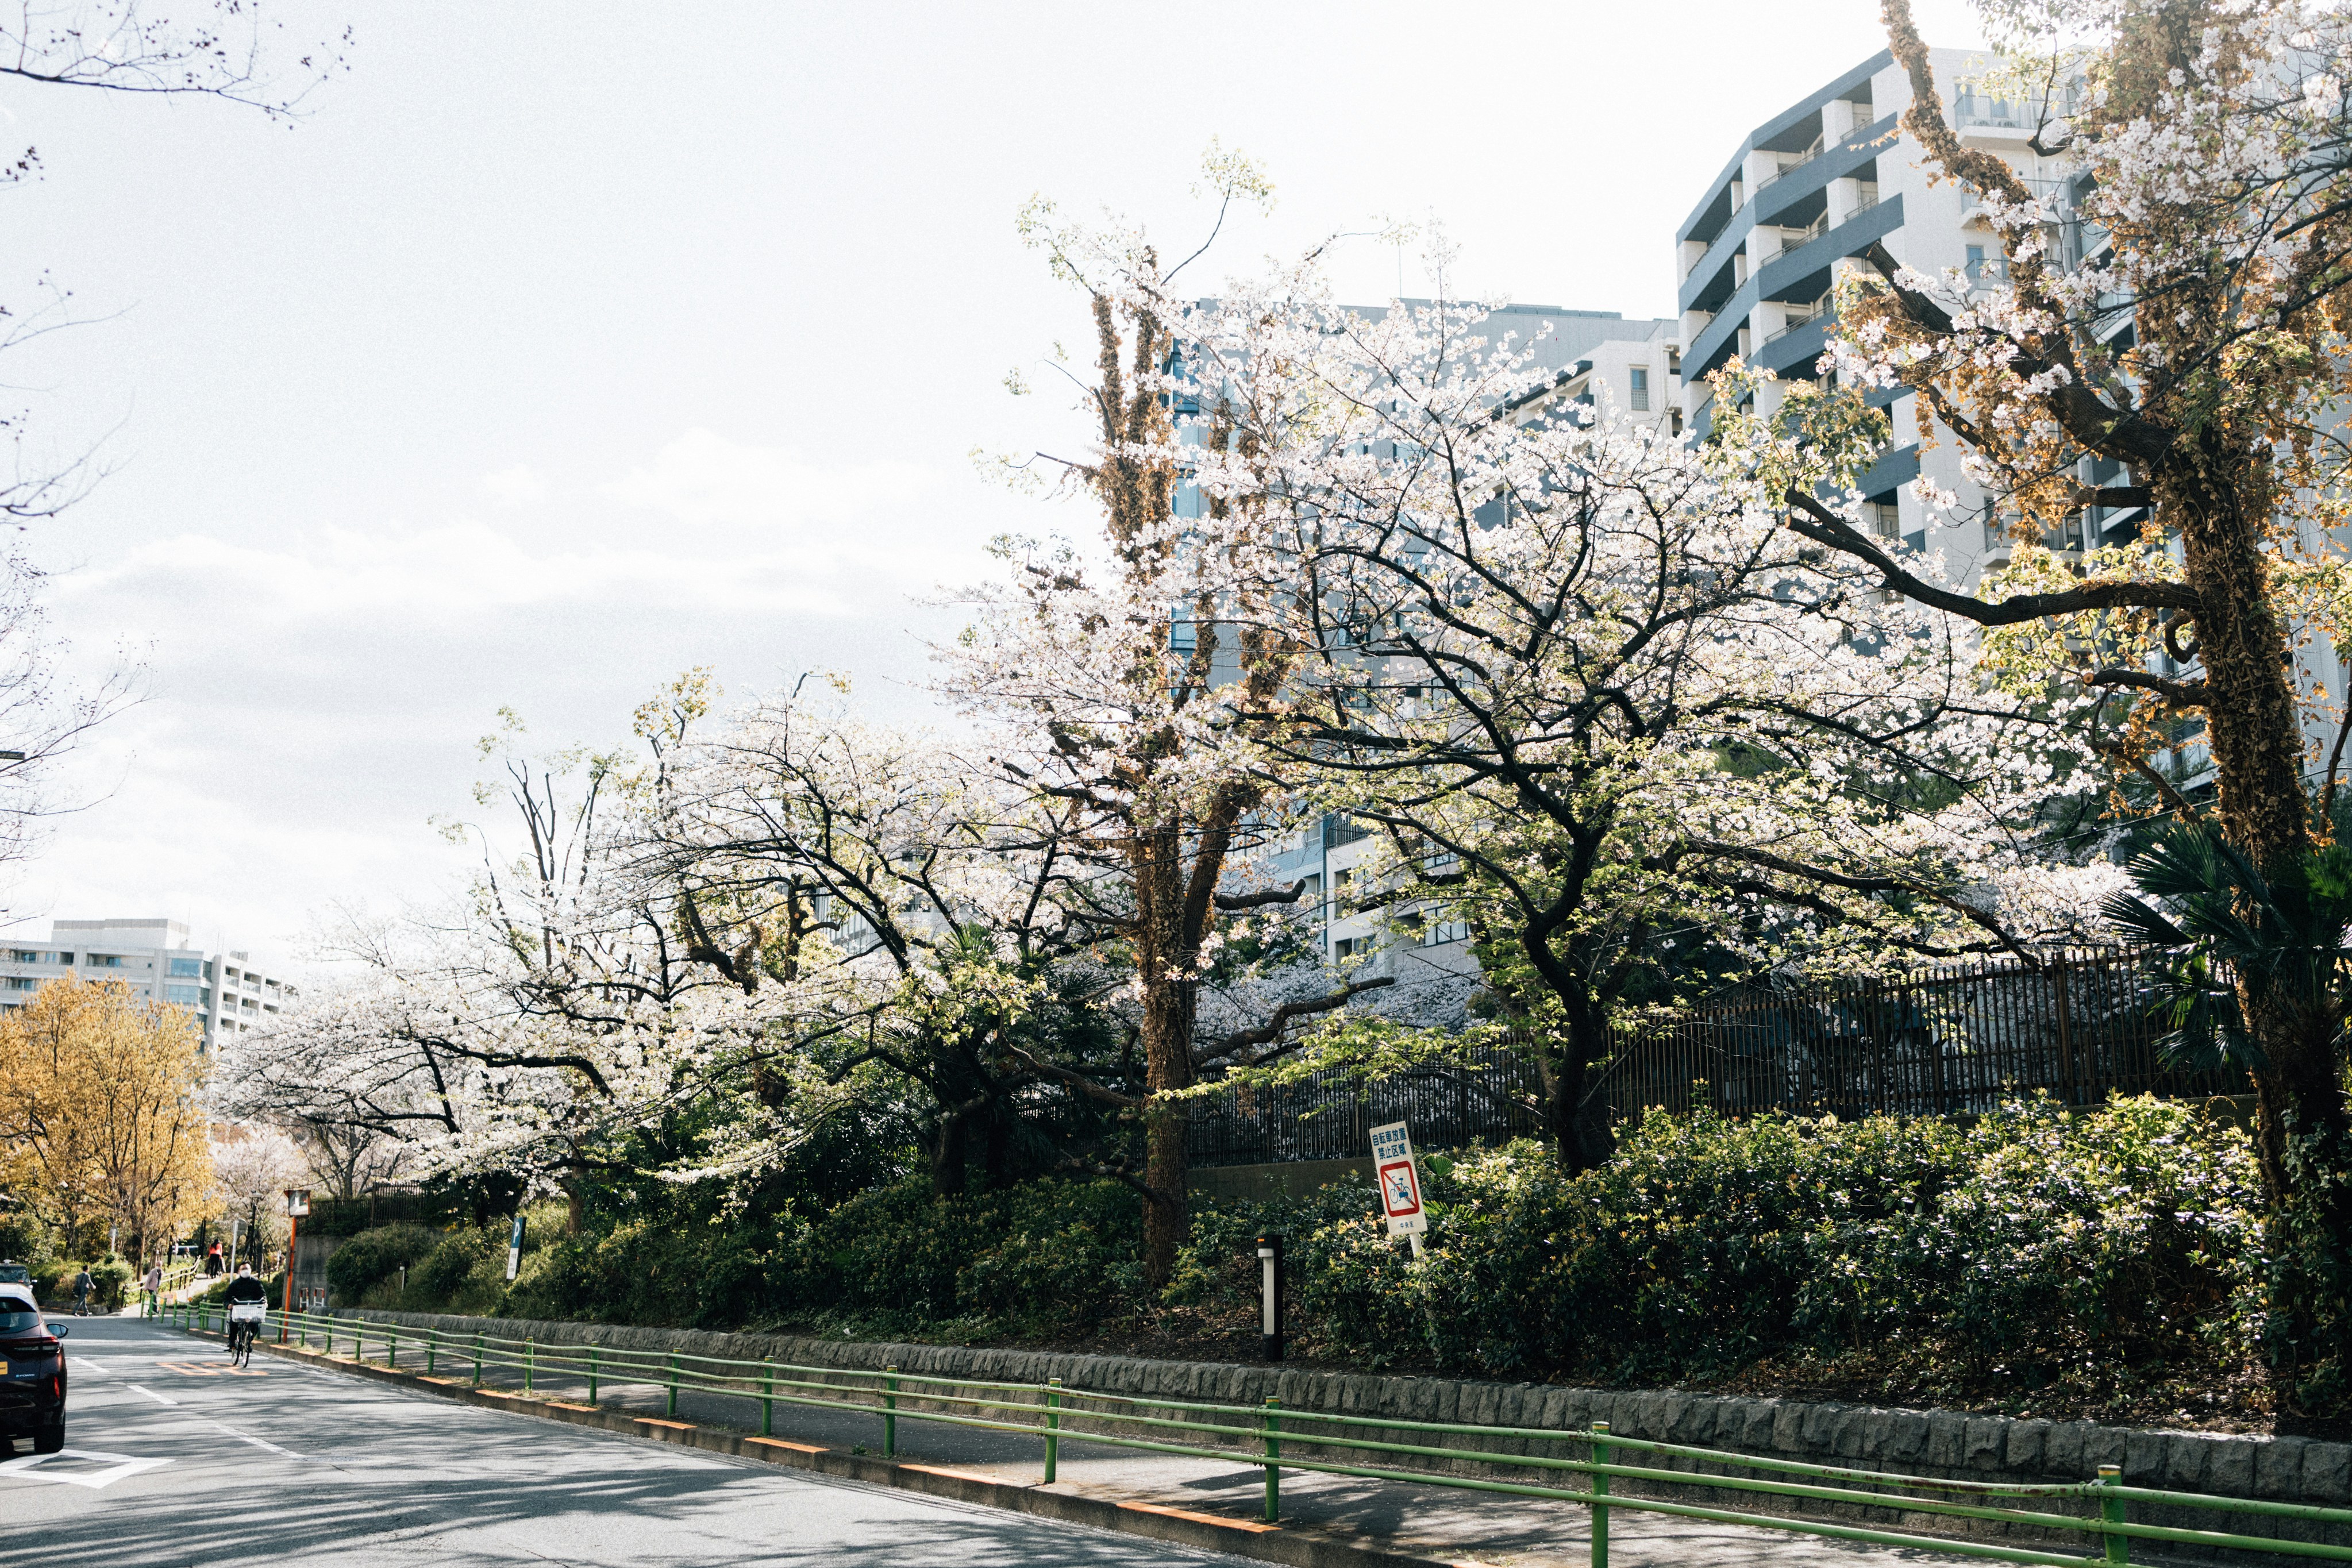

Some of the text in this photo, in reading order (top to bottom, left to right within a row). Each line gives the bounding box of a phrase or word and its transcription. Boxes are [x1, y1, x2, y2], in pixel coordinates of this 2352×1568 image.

[1372, 1127, 1407, 1146] 自転車放置
[1378, 1142, 1406, 1159] 禁止区域
[513, 1222, 520, 1243] P
